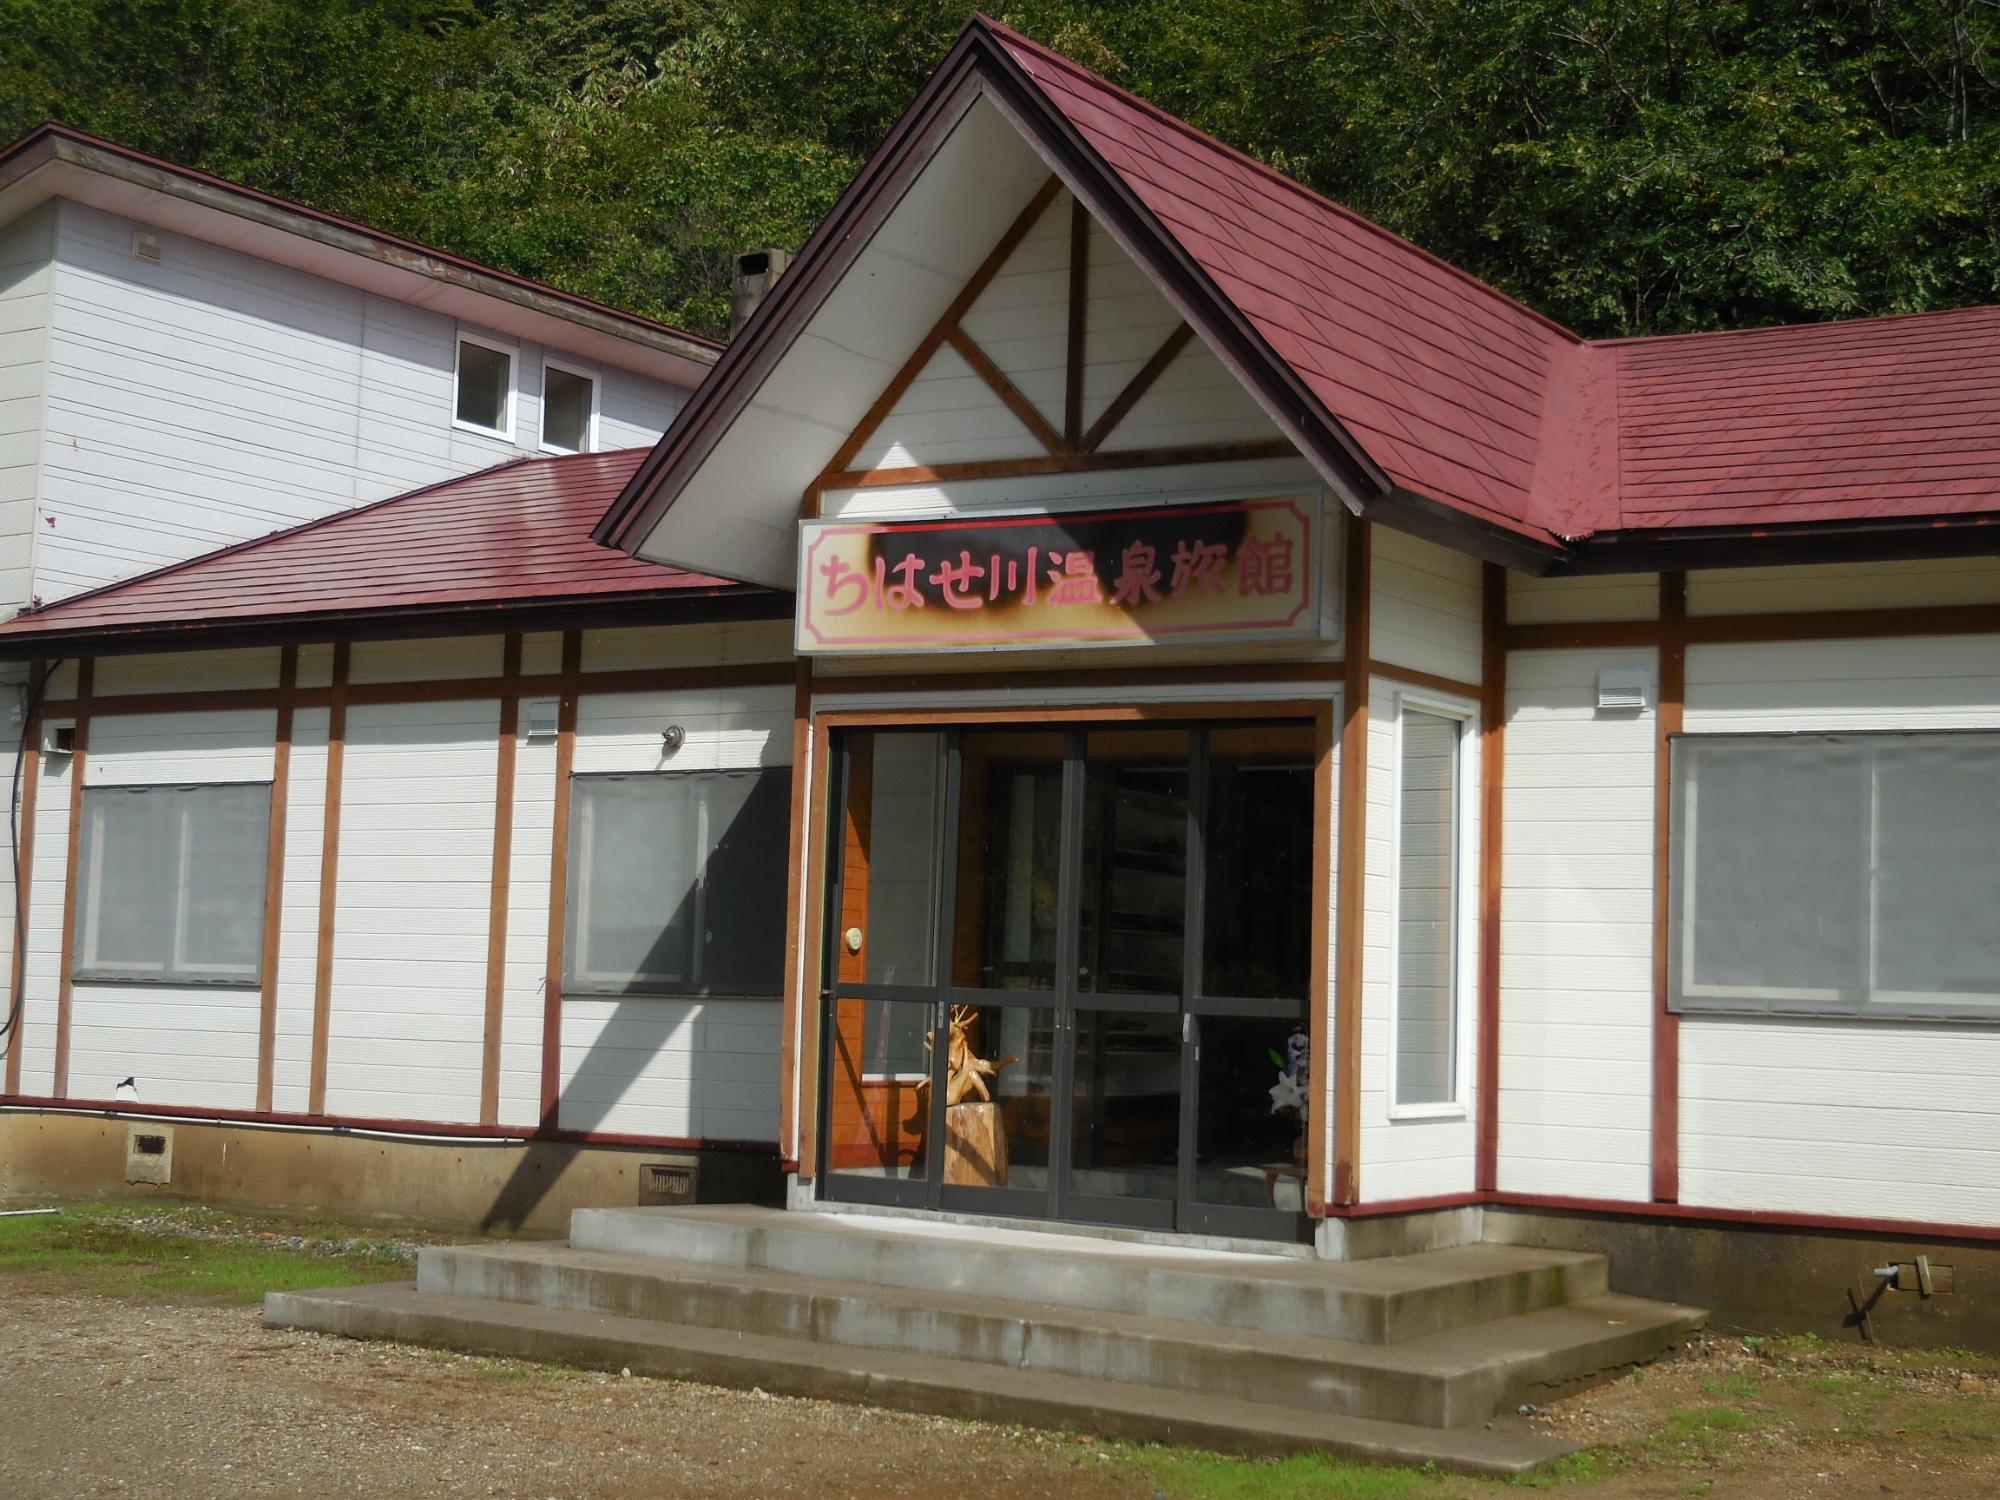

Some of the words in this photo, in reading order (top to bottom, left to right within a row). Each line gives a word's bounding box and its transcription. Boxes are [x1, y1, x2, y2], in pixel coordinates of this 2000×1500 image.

[819, 533, 1294, 617] ちはせ川温泉旅館
